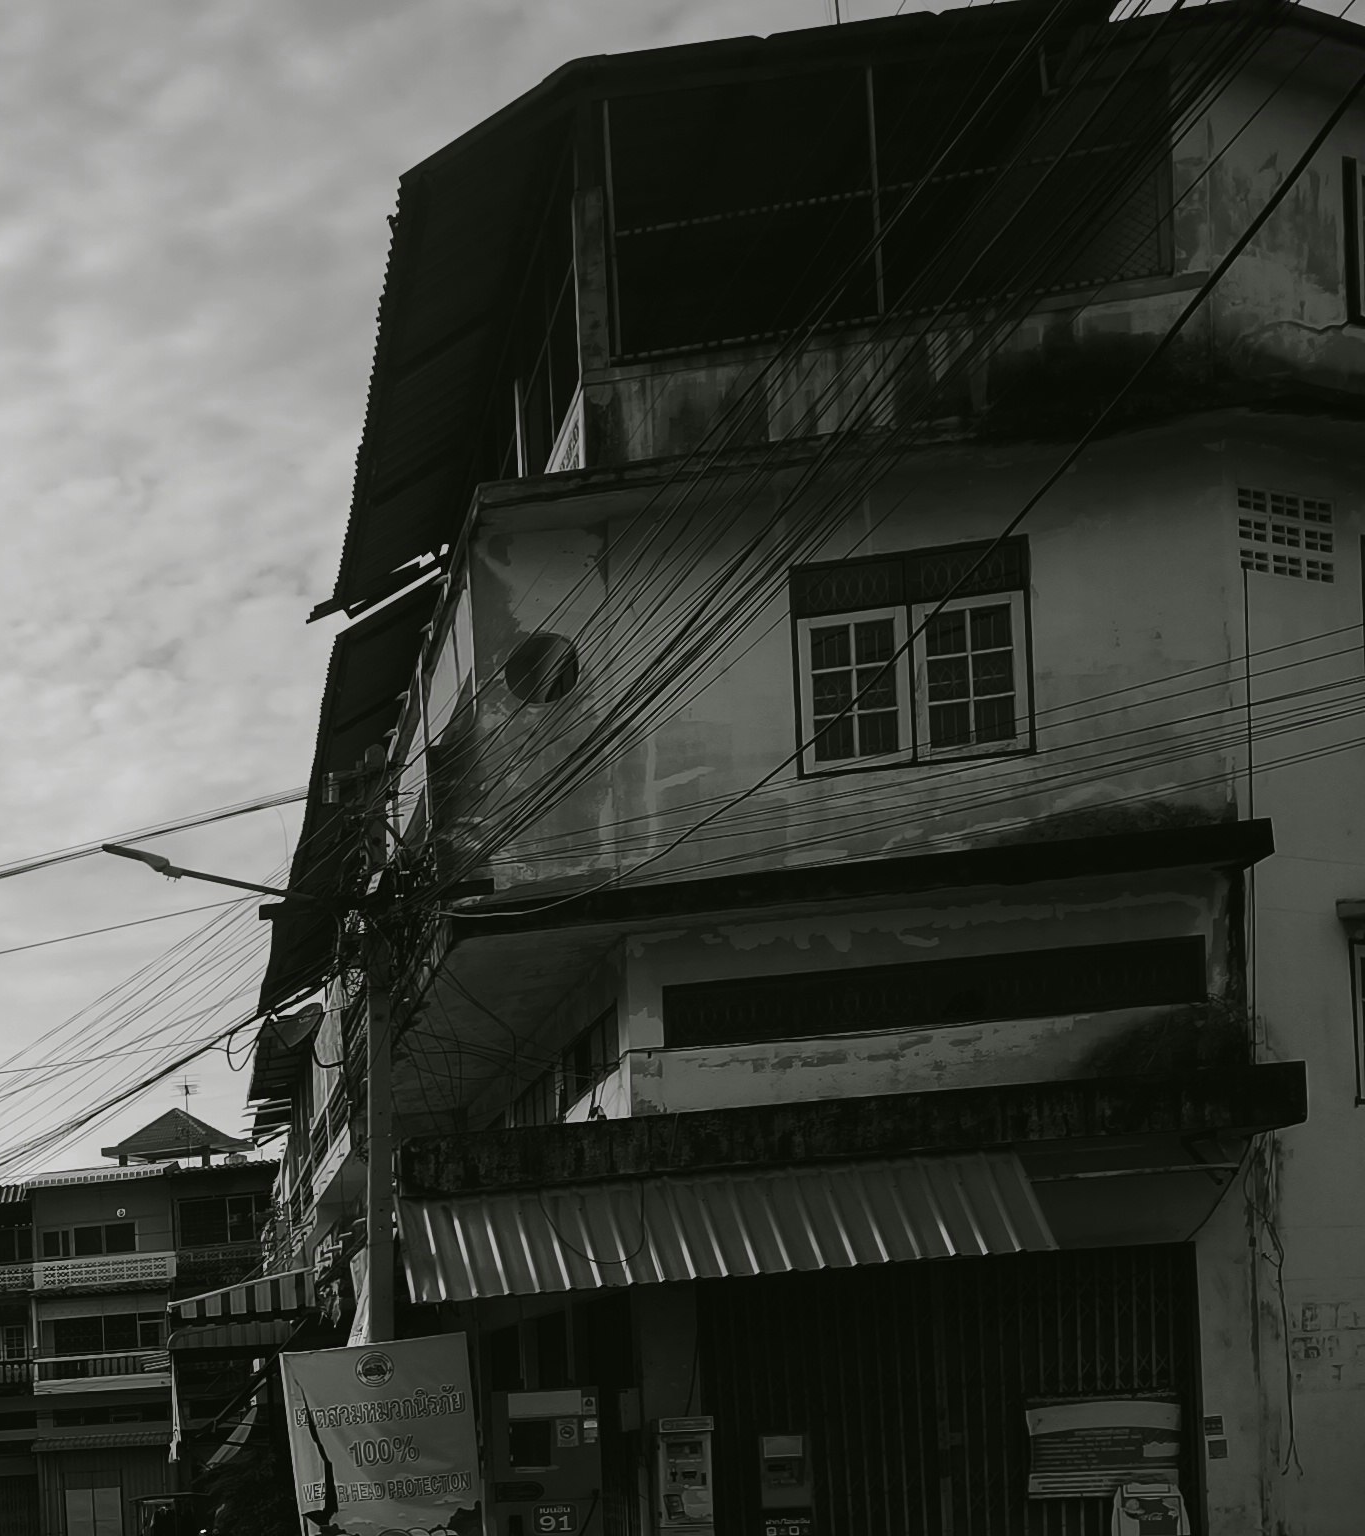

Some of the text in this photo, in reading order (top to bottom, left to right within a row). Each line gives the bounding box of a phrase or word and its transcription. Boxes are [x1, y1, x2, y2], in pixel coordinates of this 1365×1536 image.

[349, 1434, 420, 1466] 100%
[350, 1481, 385, 1501] HEAD
[386, 1471, 471, 1500] PROTECTION
[539, 1515, 573, 1531] 91
